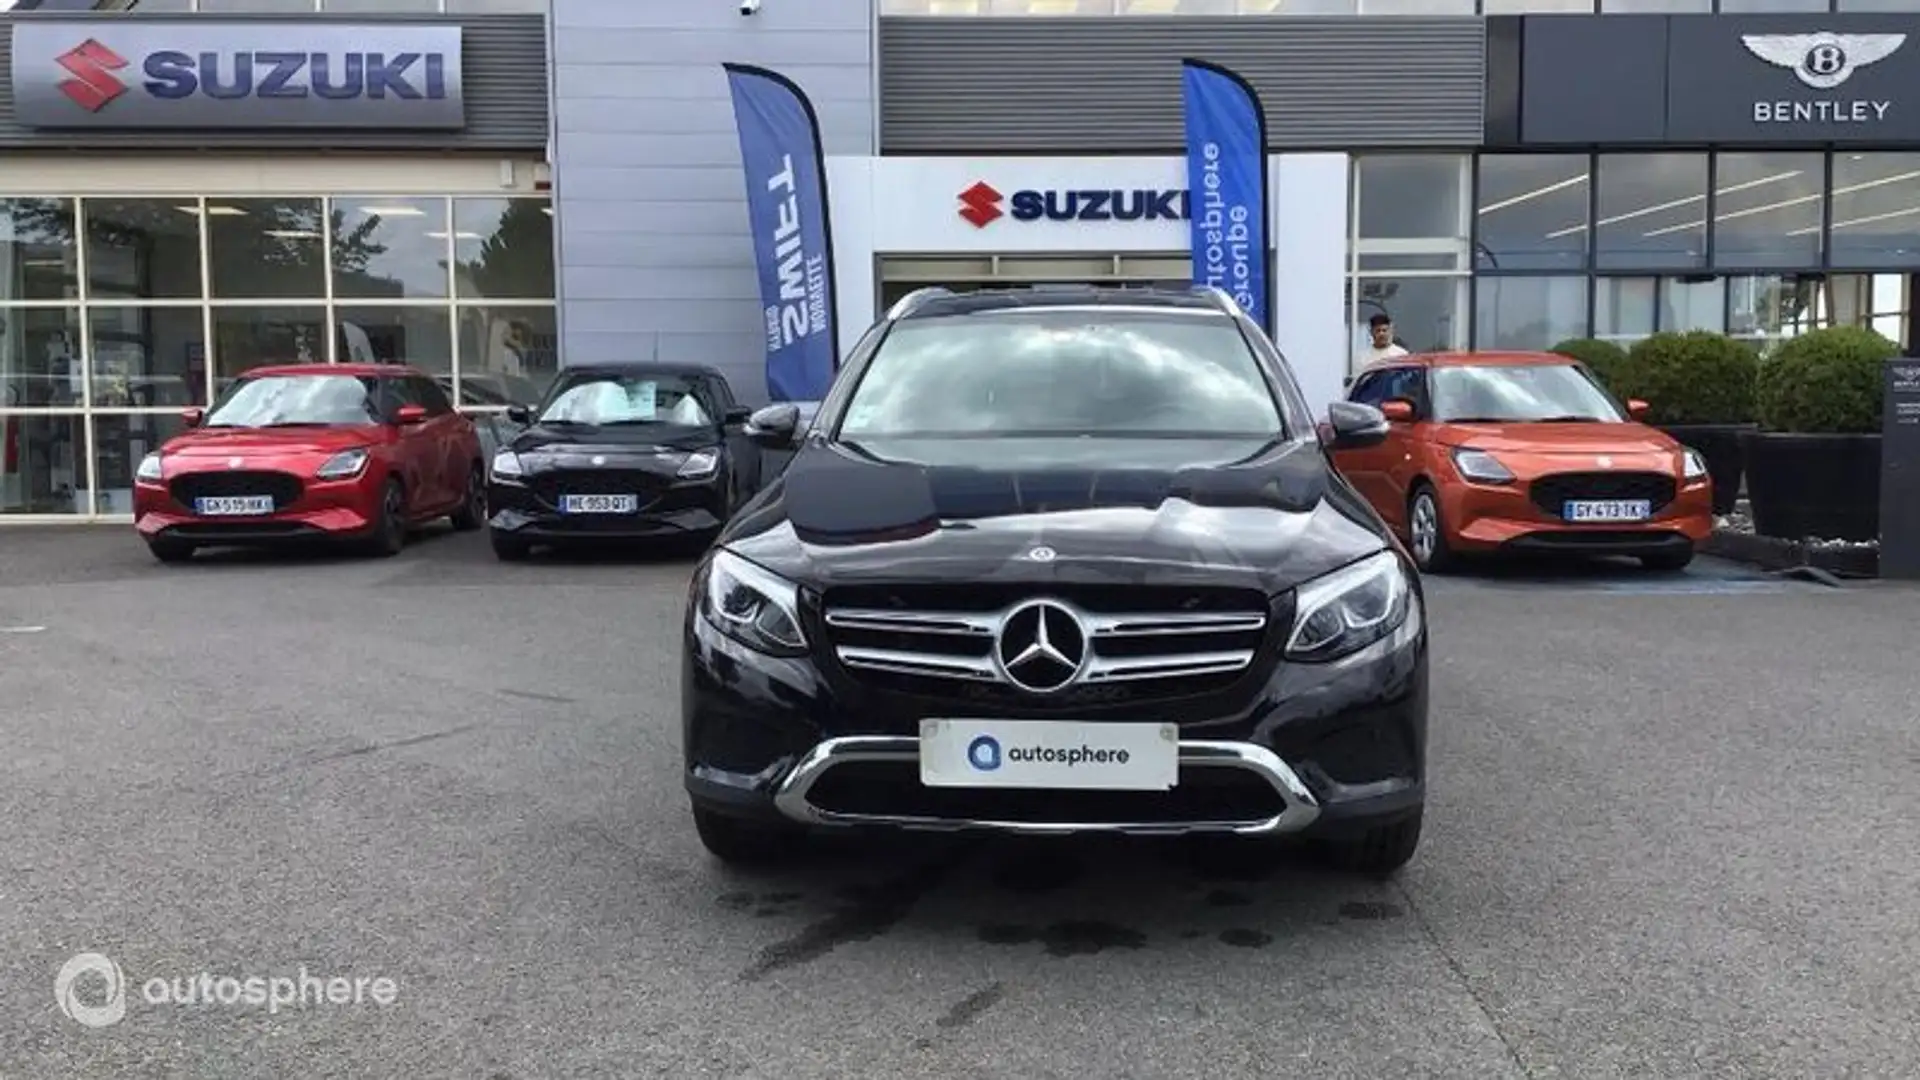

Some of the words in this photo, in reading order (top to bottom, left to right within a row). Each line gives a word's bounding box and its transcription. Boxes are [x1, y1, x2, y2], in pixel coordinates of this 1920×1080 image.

[143, 51, 447, 100] SUZUKI
[1753, 101, 1890, 121] BENTLEY
[1010, 189, 1192, 221] SUZUKI
[1008, 744, 1130, 767] autosphere
